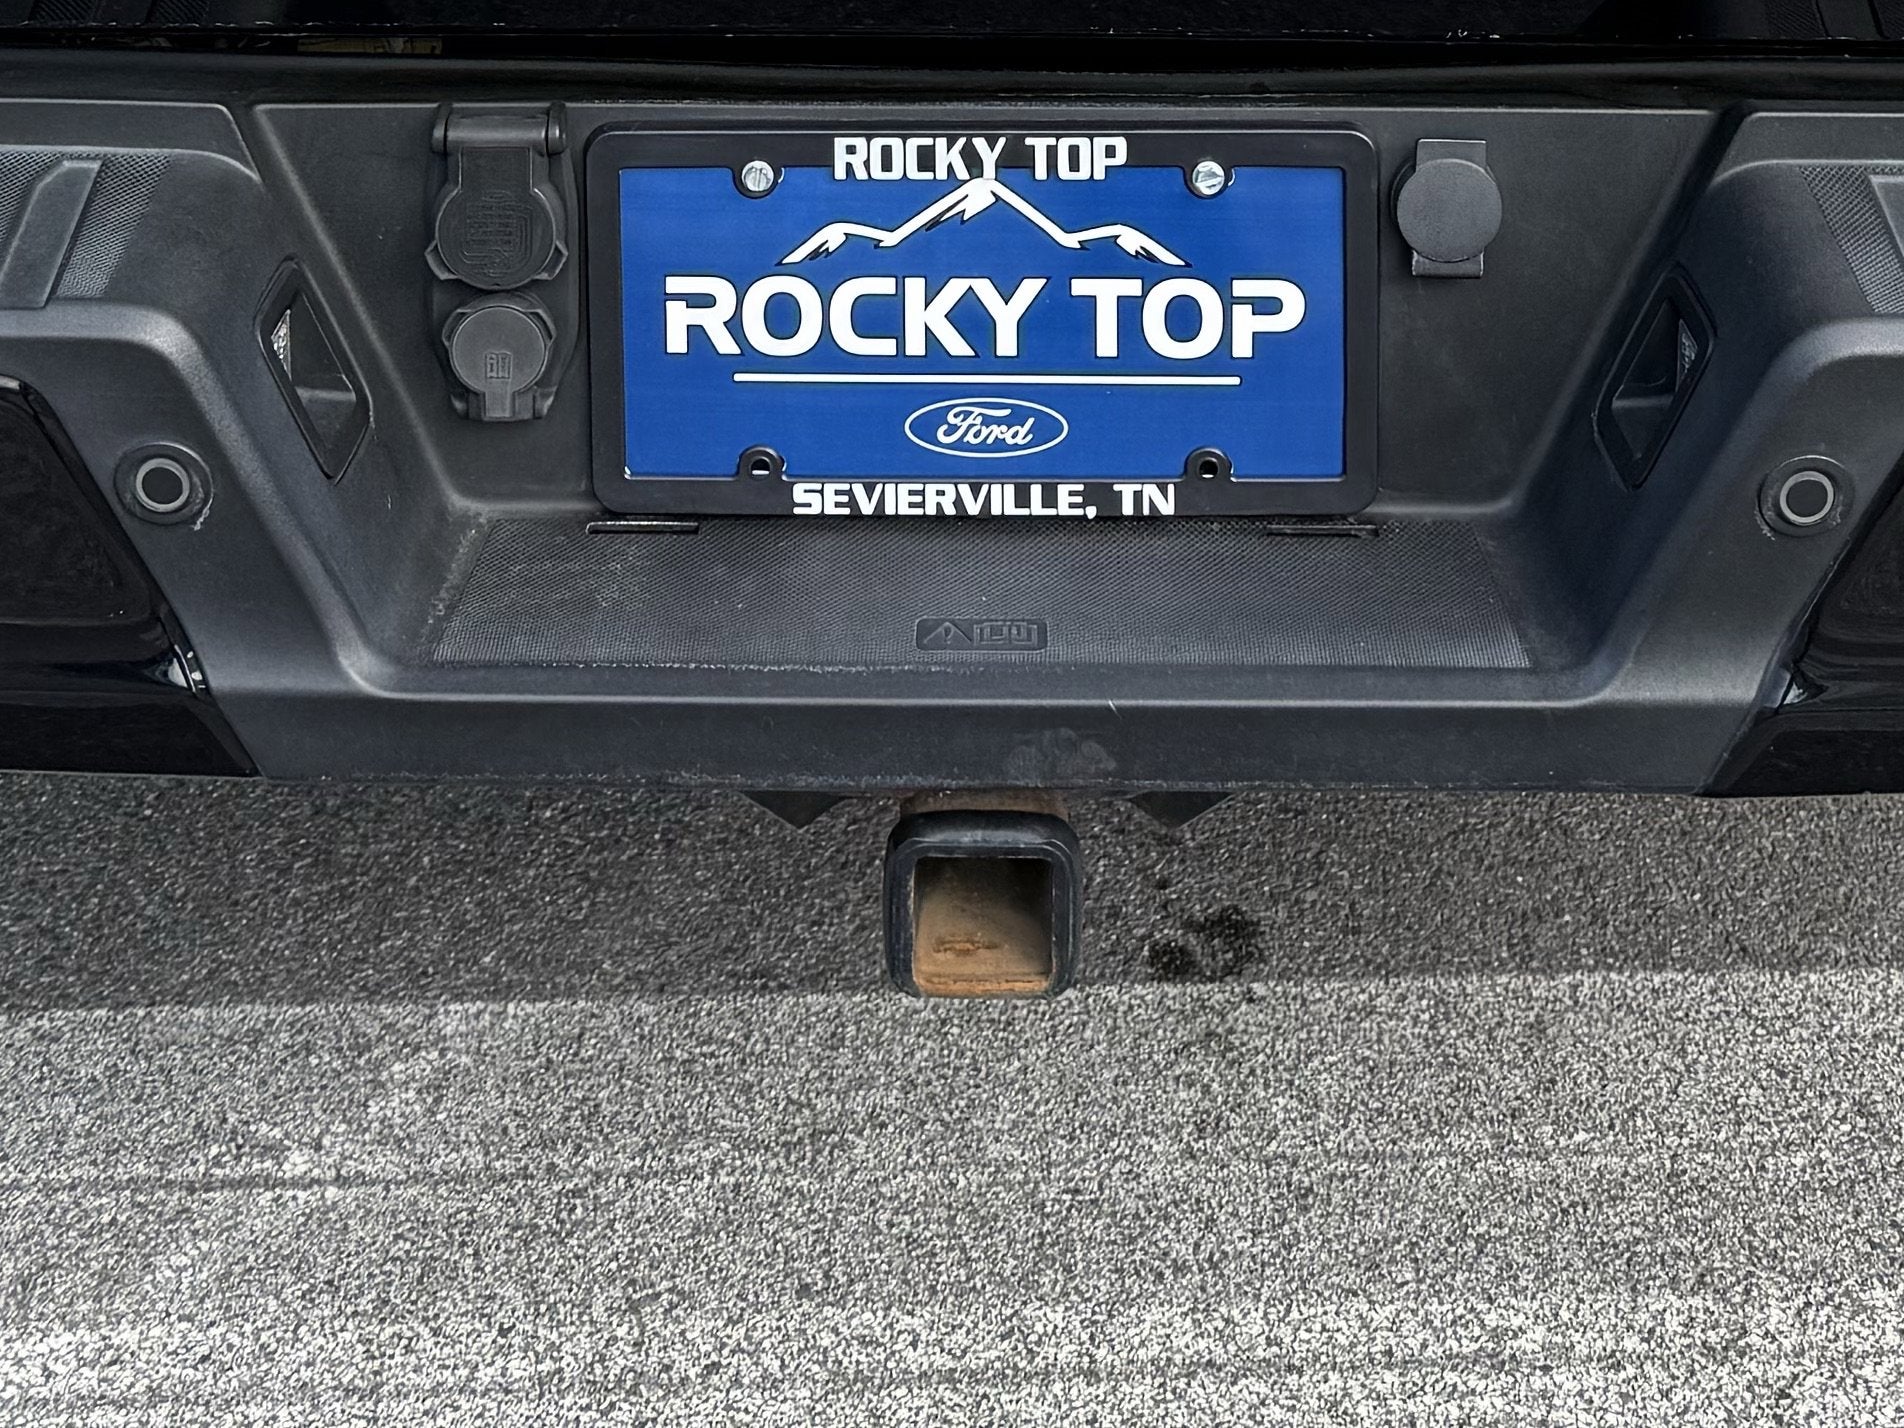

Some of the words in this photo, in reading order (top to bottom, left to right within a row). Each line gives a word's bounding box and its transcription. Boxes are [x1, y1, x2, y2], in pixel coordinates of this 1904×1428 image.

[833, 136, 1006, 181] ROCKY
[1025, 136, 1128, 181] TOP
[665, 275, 1047, 357] ROCKY
[1071, 278, 1306, 359] TOP
[935, 405, 1034, 446] Ford
[792, 482, 1097, 520] SEVIERVILLE,
[1112, 482, 1176, 516] TN
